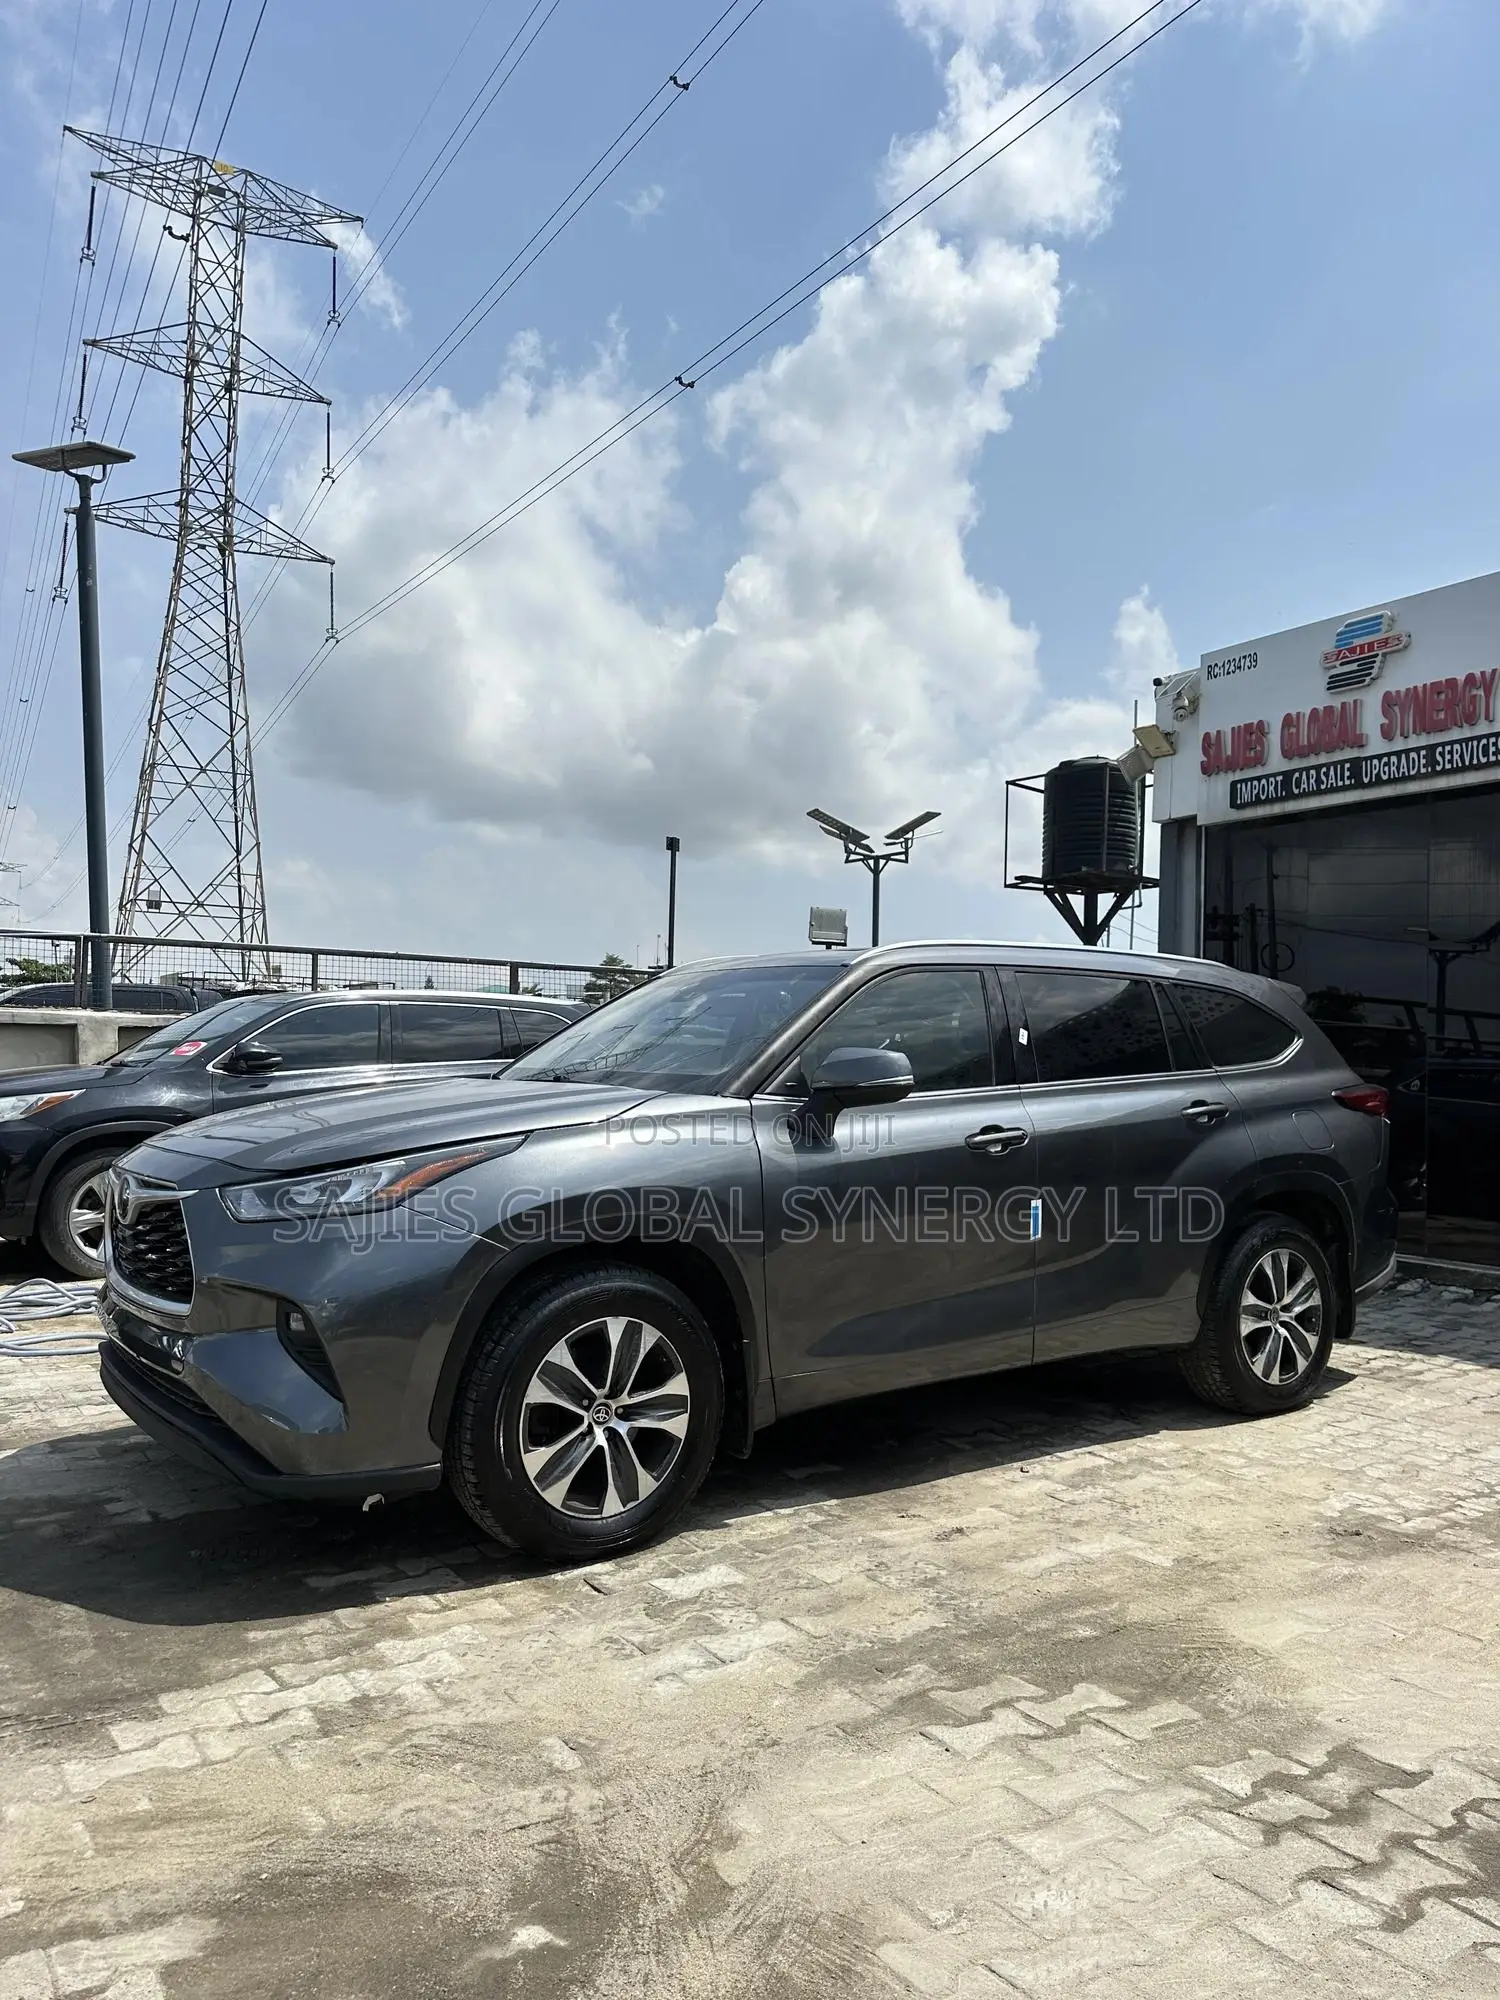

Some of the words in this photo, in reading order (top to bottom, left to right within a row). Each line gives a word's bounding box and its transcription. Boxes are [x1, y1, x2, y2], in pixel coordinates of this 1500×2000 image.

[1206, 651, 1258, 681] RC:1234739
[1322, 633, 1404, 665] SAJIES
[1200, 719, 1268, 777] SAJIES
[1280, 699, 1368, 760] GLOBAL
[1380, 668, 1500, 741] SYNERGY
[1236, 775, 1286, 805] IMPORT.
[1292, 769, 1316, 794] CAR
[1320, 761, 1355, 789] SALE.
[1362, 749, 1431, 783] UPGRADE.
